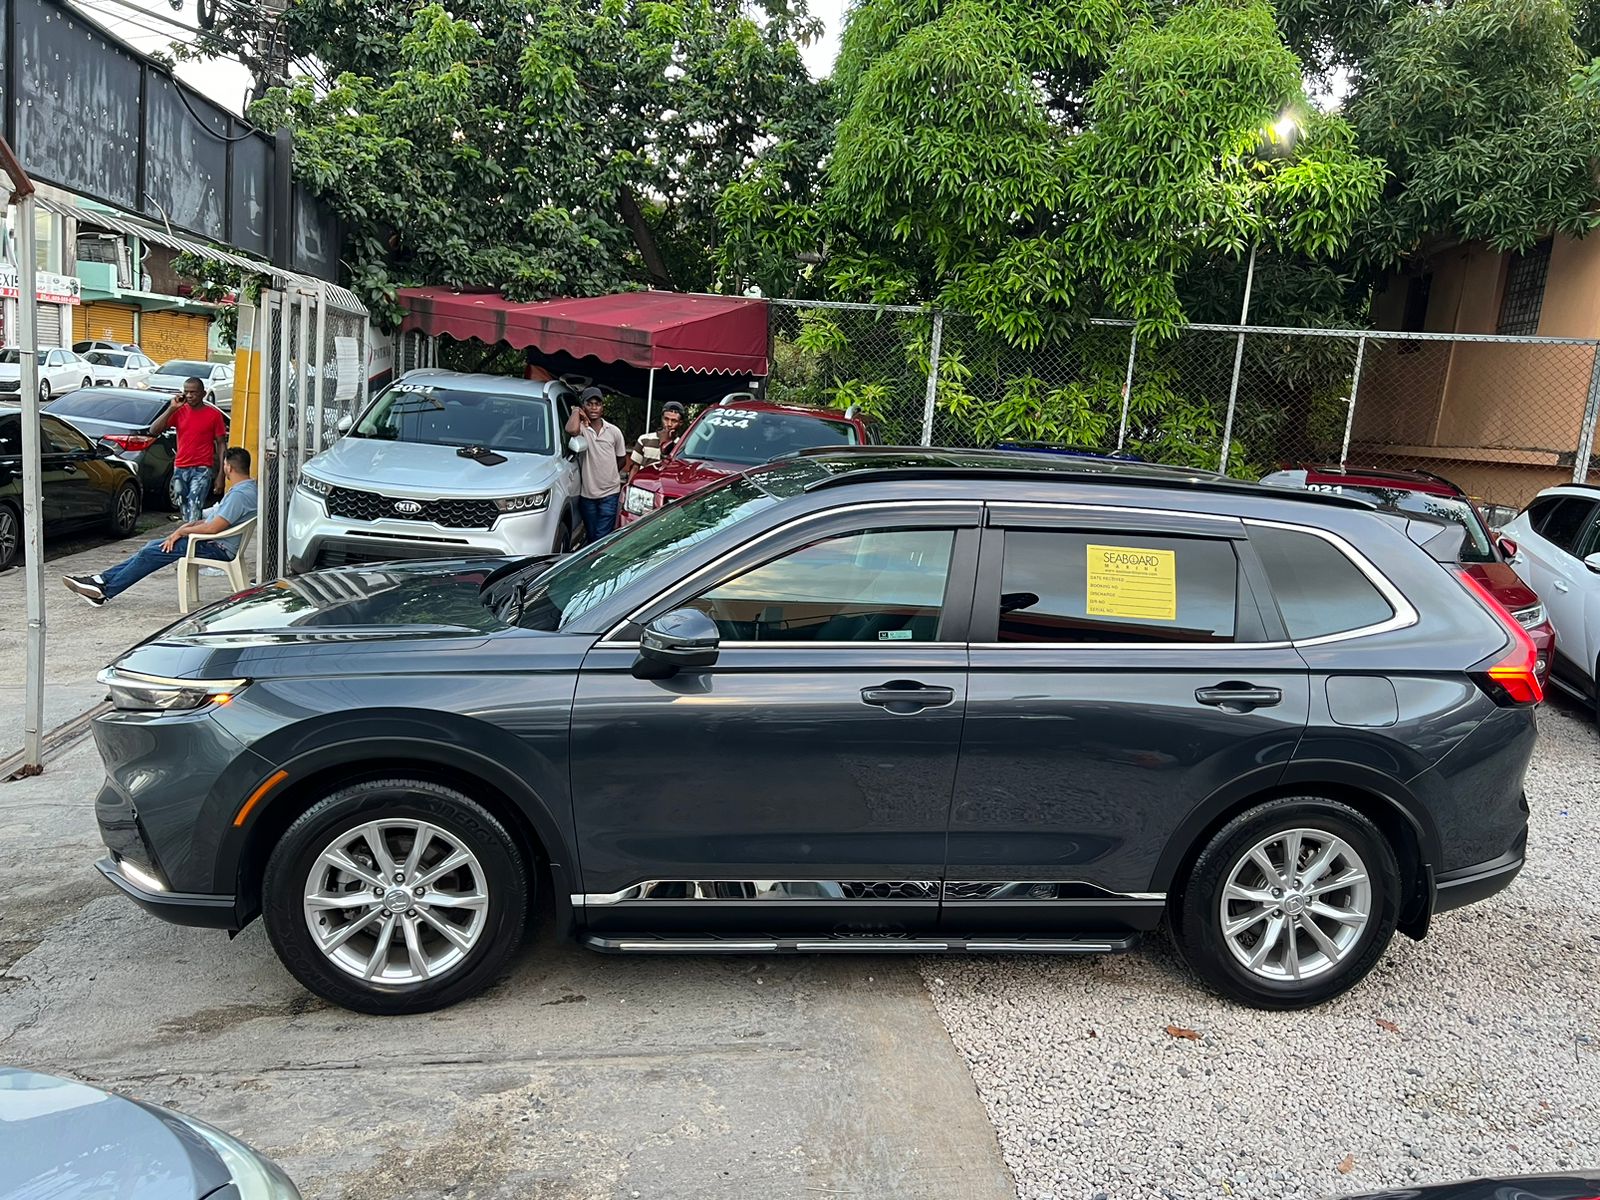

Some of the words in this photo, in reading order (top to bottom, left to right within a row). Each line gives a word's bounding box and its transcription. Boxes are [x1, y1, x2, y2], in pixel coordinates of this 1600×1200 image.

[390, 384, 434, 393] 2021
[712, 408, 758, 419] 2022
[707, 417, 749, 428] 4x4
[1304, 484, 1343, 495] 021
[1103, 552, 1159, 566] SEABOARD
[1104, 563, 1157, 571] MARINE
